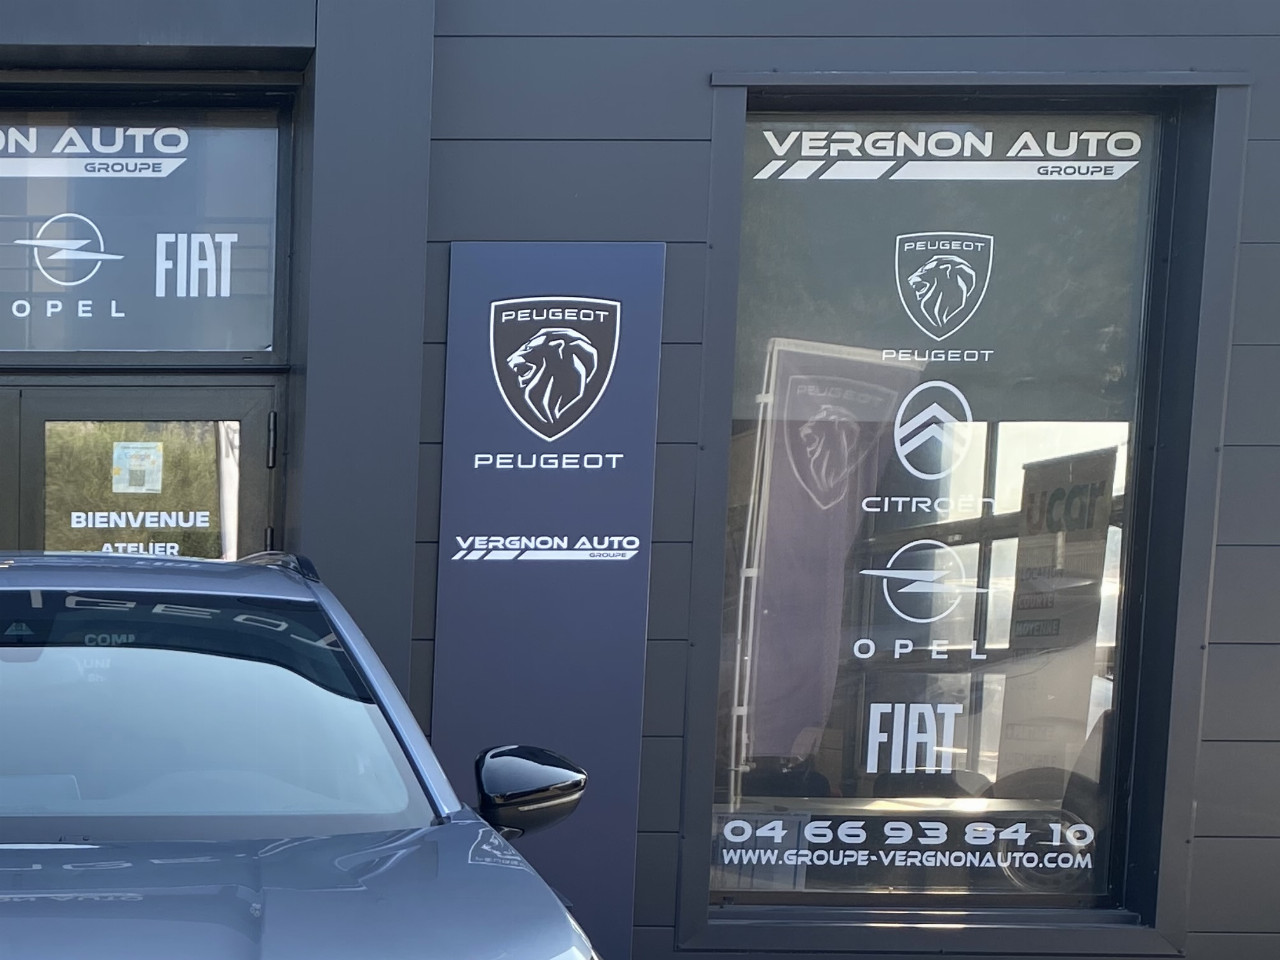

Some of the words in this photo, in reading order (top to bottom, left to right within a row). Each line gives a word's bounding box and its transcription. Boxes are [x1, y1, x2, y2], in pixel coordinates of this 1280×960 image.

[51, 127, 189, 154] AUTO
[762, 131, 993, 157] VERGNON
[1006, 131, 1142, 157] AUTO
[84, 162, 163, 173] GROUPE
[1037, 165, 1114, 176] GROUPE
[904, 240, 985, 252] PEUGEOT
[155, 233, 238, 297] FIAT
[12, 300, 125, 317] OPEL
[502, 309, 609, 322] PEUGEOT
[881, 350, 994, 362] PEUGEOT
[474, 454, 624, 469] PEUGEOT
[71, 512, 210, 528] BIENVENUE
[102, 543, 179, 555] ATELIER
[456, 536, 568, 549] VERGNON
[574, 536, 640, 549] AUTO
[853, 638, 987, 660] OPEL
[866, 703, 964, 774] FIAT
[723, 820, 788, 843] 04
[804, 820, 867, 844] 66
[884, 821, 947, 845] 93
[964, 822, 1031, 846] 84
[1050, 823, 1095, 847] 10
[722, 848, 1093, 869] WWW.GROUPE-VERGNONAUTO.COM
